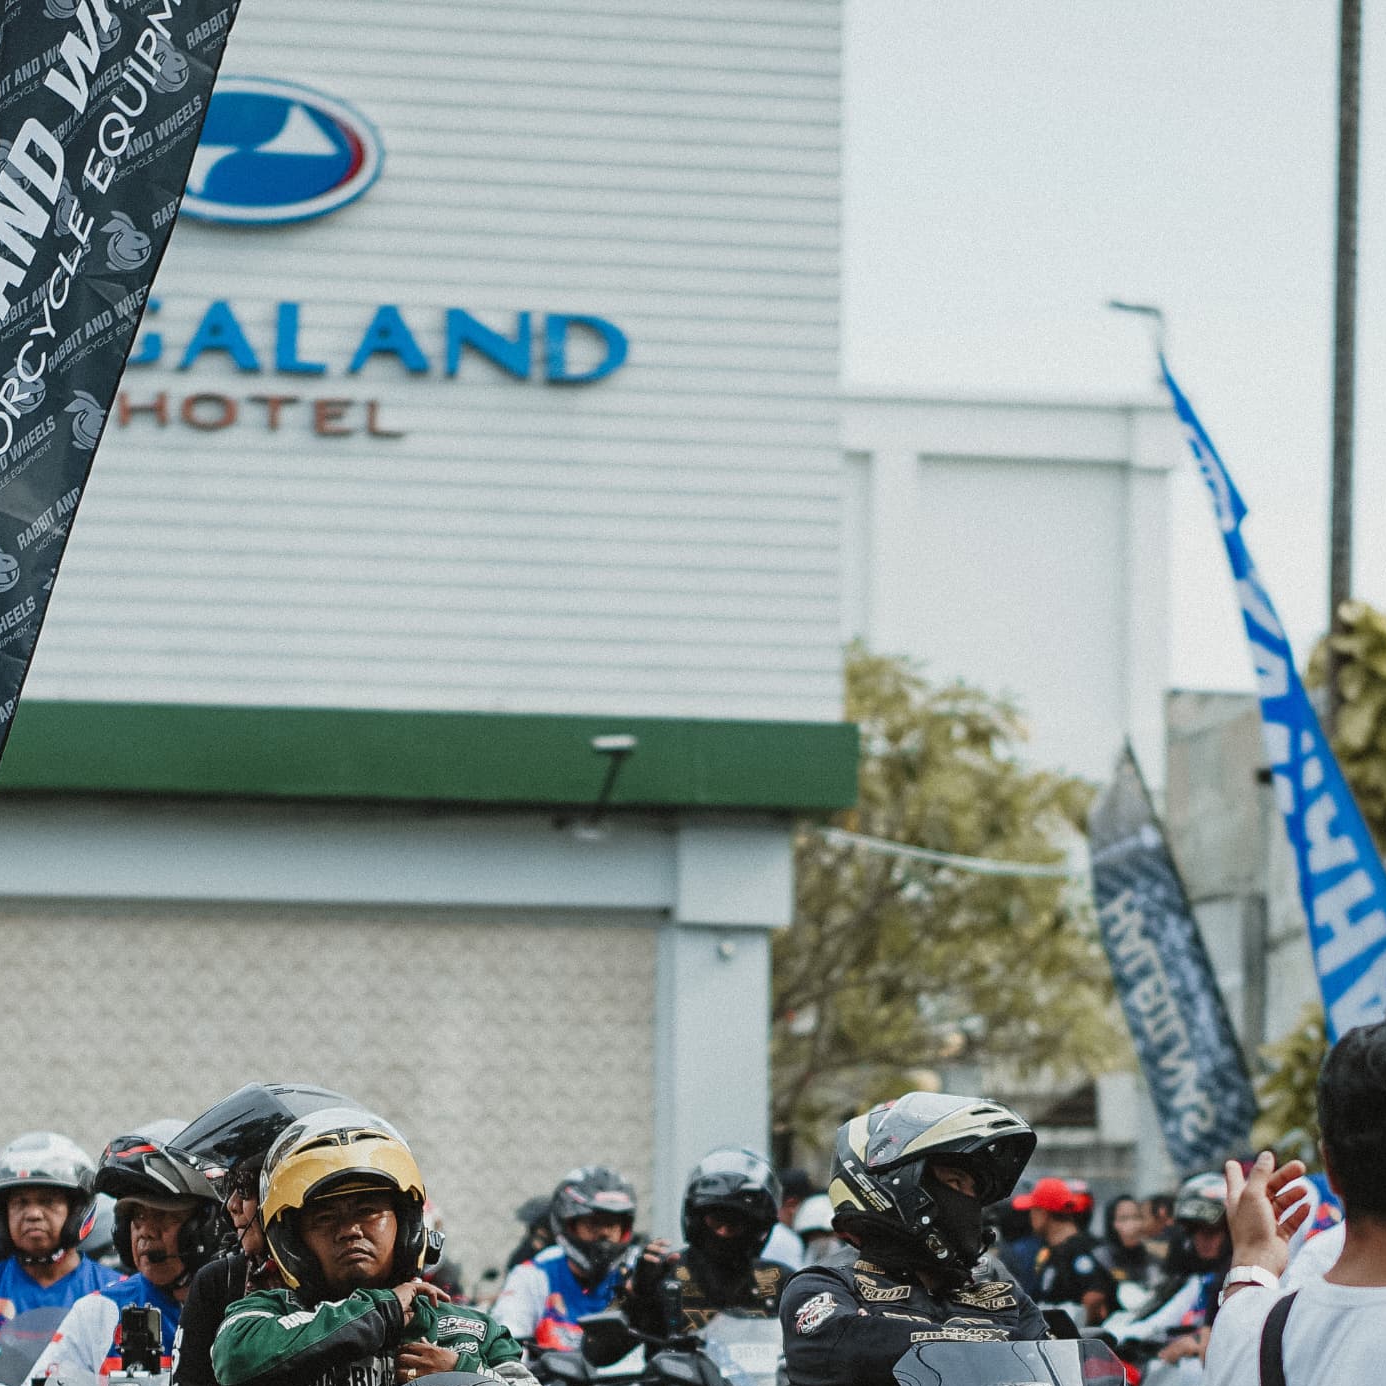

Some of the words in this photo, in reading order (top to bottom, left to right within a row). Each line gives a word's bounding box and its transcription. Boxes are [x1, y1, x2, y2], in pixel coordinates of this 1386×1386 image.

[155, 95, 203, 141] WHEELS
[47, 333, 86, 374] RABBIT
[85, 311, 112, 347] AND
[9, 415, 57, 461] WHEELS
[118, 393, 404, 437] HOTEL
[17, 517, 54, 551] RABBIT
